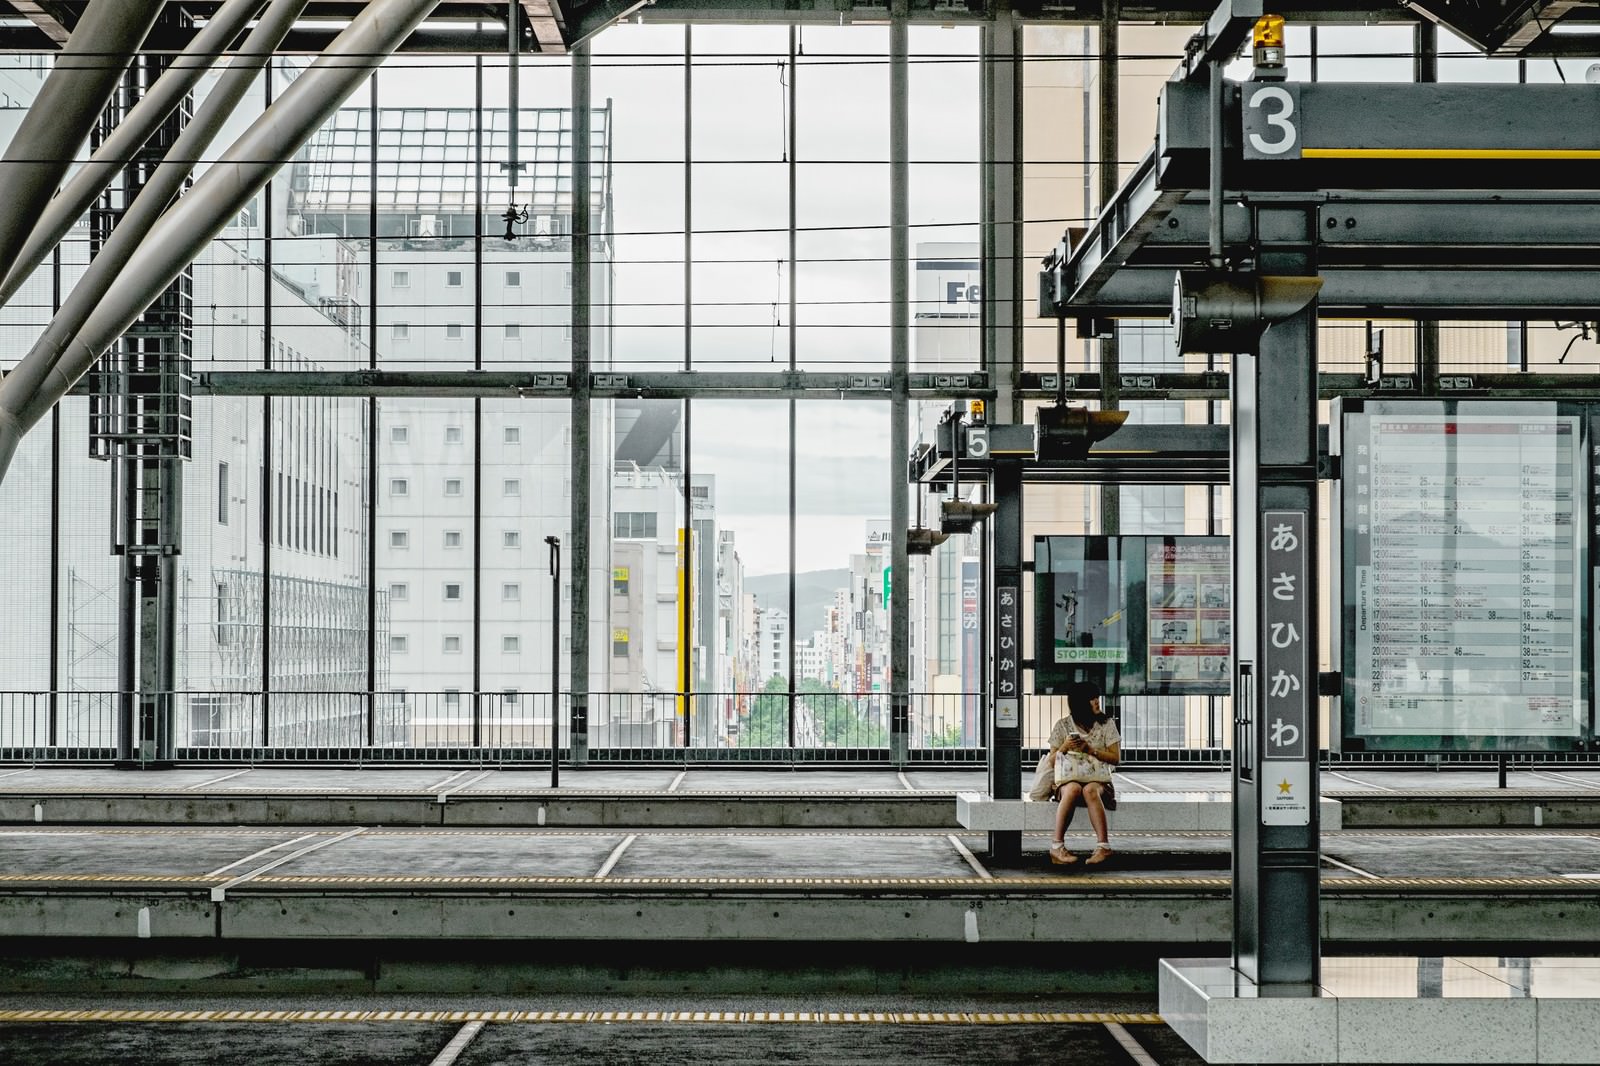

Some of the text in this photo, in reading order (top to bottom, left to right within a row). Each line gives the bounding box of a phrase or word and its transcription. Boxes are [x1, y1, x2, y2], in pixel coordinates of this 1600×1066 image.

[1249, 86, 1296, 154] 3
[969, 430, 987, 456] 5
[1374, 525, 1380, 535] 10
[1454, 525, 1462, 535] 24
[1374, 537, 1380, 547] 11
[1374, 549, 1380, 559] 12
[1522, 550, 1531, 560] 25
[1374, 561, 1380, 571] 13
[1374, 573, 1380, 583] 14
[1522, 574, 1531, 584] 26
[1374, 585, 1380, 595] 15
[1420, 585, 1428, 595] 15
[1522, 586, 1531, 596] 25
[963, 578, 977, 629] SEIBU
[1374, 598, 1380, 608] 16
[1420, 598, 1428, 608] 10
[1522, 598, 1531, 608] 30
[1374, 610, 1380, 620] 17
[1374, 622, 1380, 632] 18
[1420, 622, 1428, 632] 30
[1522, 622, 1531, 632] 34
[1270, 524, 1300, 747] あさひかわ
[1374, 634, 1380, 644] 19
[1420, 634, 1428, 644] 15
[1522, 634, 1530, 644] 31
[1000, 592, 1014, 693] あさひかわ
[1372, 646, 1380, 656] 20
[1420, 646, 1428, 656] 30
[1522, 646, 1531, 656] 38
[1372, 658, 1380, 668] 21
[1522, 658, 1531, 668] 52
[1372, 670, 1380, 680] 22
[1522, 670, 1531, 680] 37
[1372, 682, 1380, 692] 23
